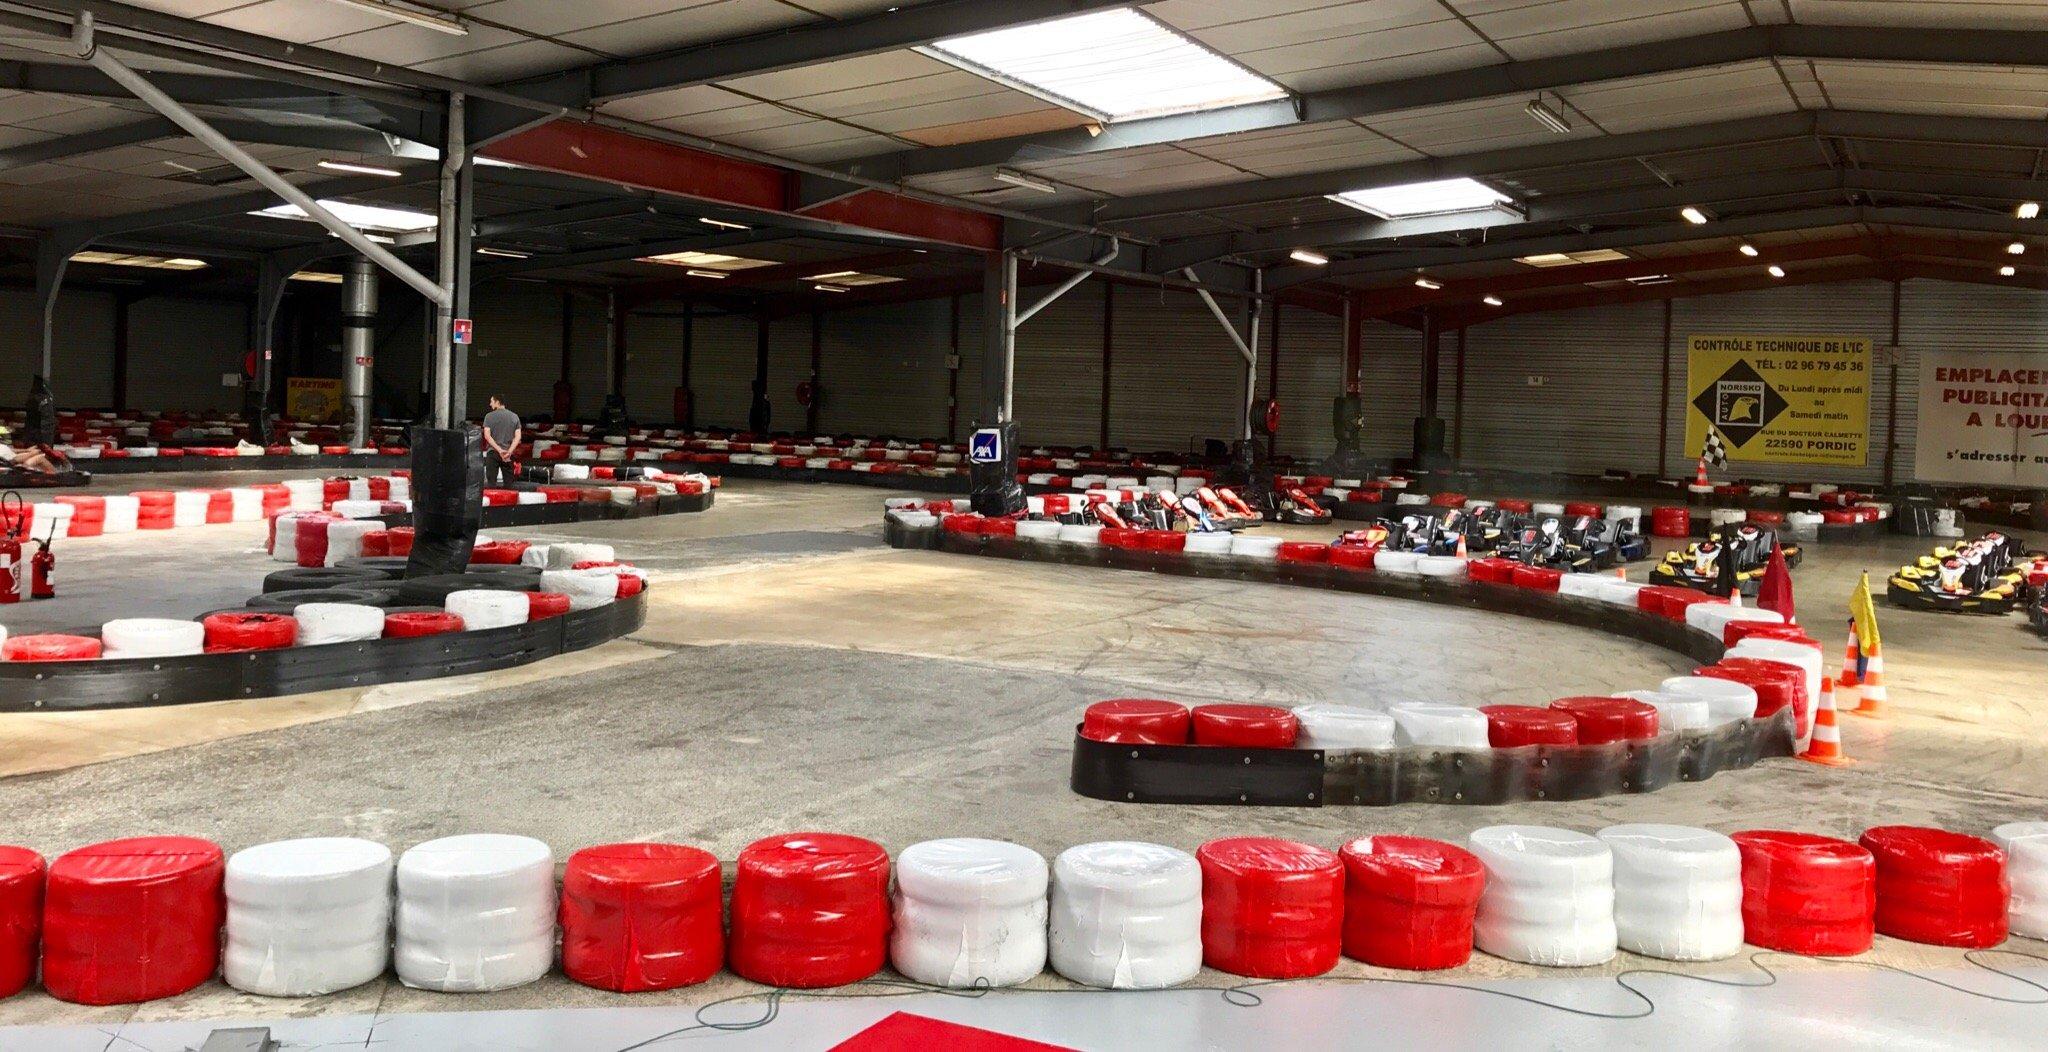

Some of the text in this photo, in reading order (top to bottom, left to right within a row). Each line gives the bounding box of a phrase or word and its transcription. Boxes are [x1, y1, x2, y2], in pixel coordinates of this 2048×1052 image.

[1756, 341, 1820, 353] TECHNIQUE
[1824, 342, 1839, 353] DE
[1756, 359, 1776, 370] TÉL
[1785, 361, 1798, 370] 02
[1801, 361, 1814, 370] 96
[1817, 361, 1831, 371] 79
[1833, 361, 1847, 371] 45
[1850, 362, 1864, 371] 36
[1720, 384, 1761, 392] NORISKO
[1778, 384, 1790, 393] Du
[1791, 385, 1815, 393] Lundi
[1843, 386, 1863, 394] midi
[1721, 393, 1729, 420] AUTO
[1789, 410, 1849, 420] Samedi matin
[1966, 412, 1983, 427] A
[1765, 439, 1857, 451] 22590 PORDIC
[972, 446, 992, 457] AXA
[1946, 449, 2027, 463] s'adresser
